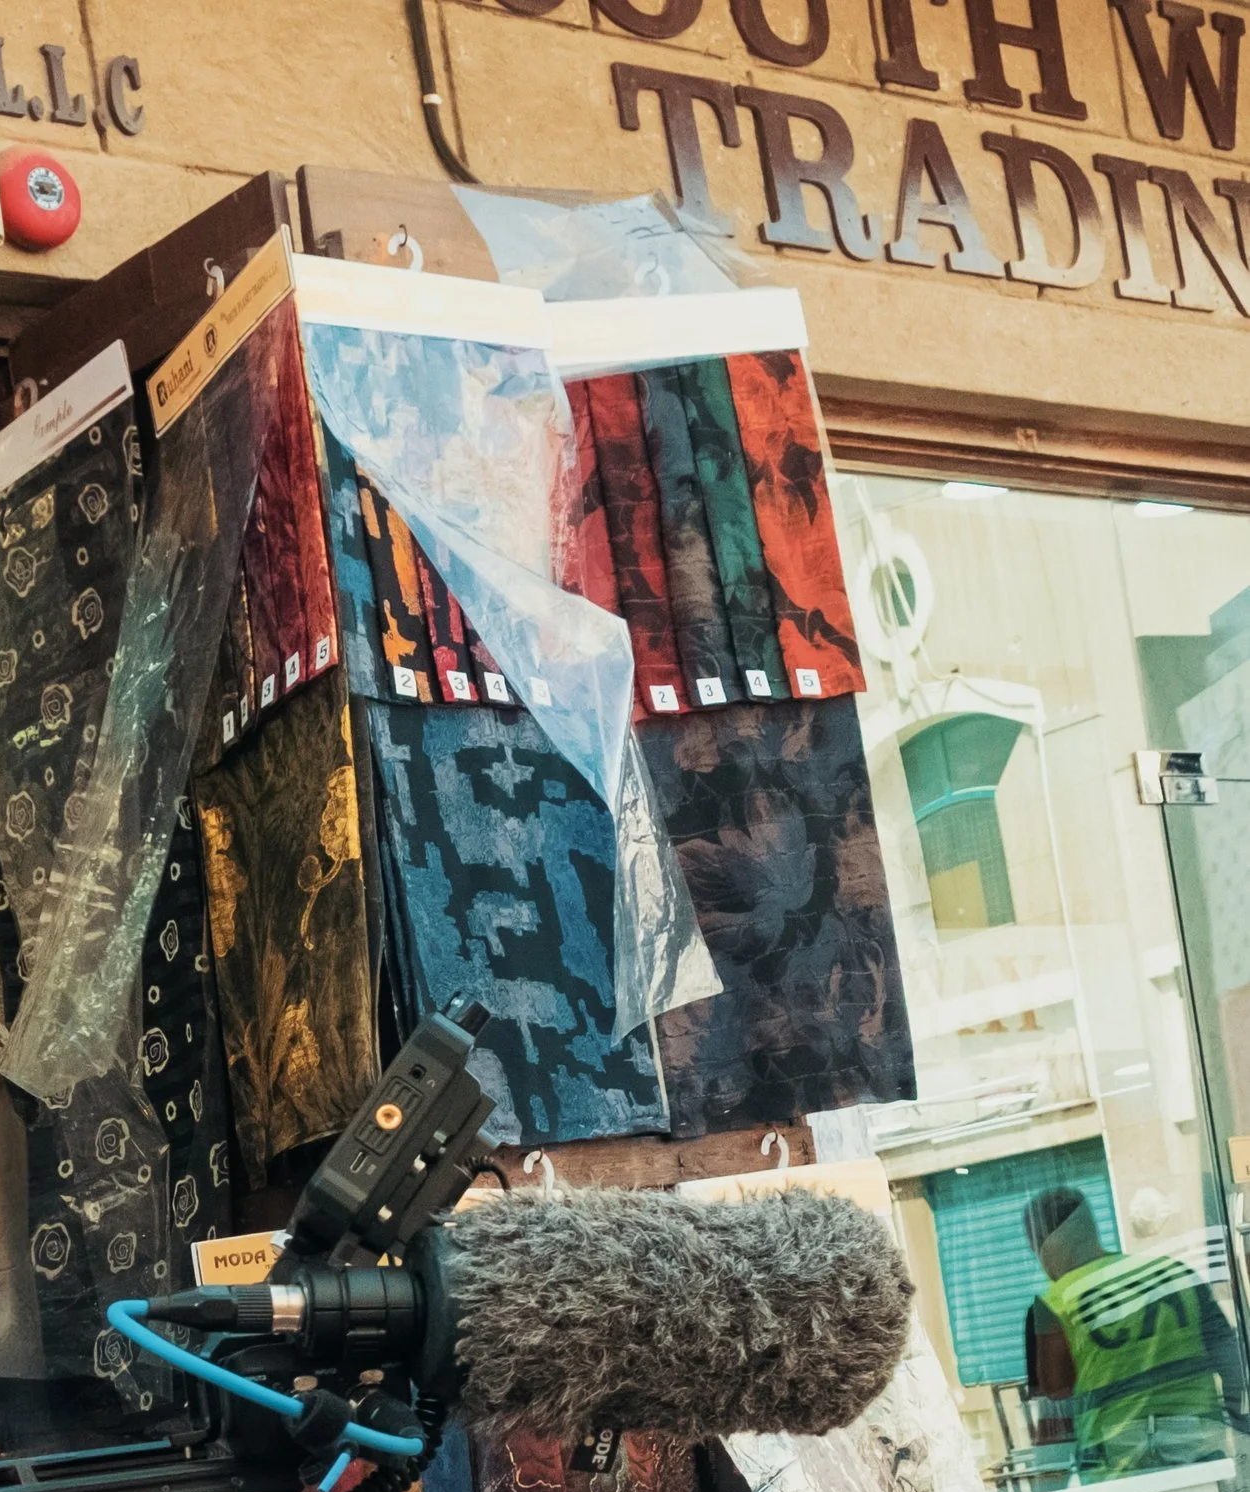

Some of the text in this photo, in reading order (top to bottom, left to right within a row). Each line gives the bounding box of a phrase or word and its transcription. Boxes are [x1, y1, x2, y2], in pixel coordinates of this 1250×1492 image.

[263, 683, 271, 698] 3
[289, 661, 296, 676] 4
[319, 644, 328, 660] 5
[401, 673, 413, 689] 2
[453, 676, 466, 691] 3
[492, 680, 503, 693] 4
[658, 674, 815, 704] 2 3 4 5
[213, 1249, 267, 1269] MODA
